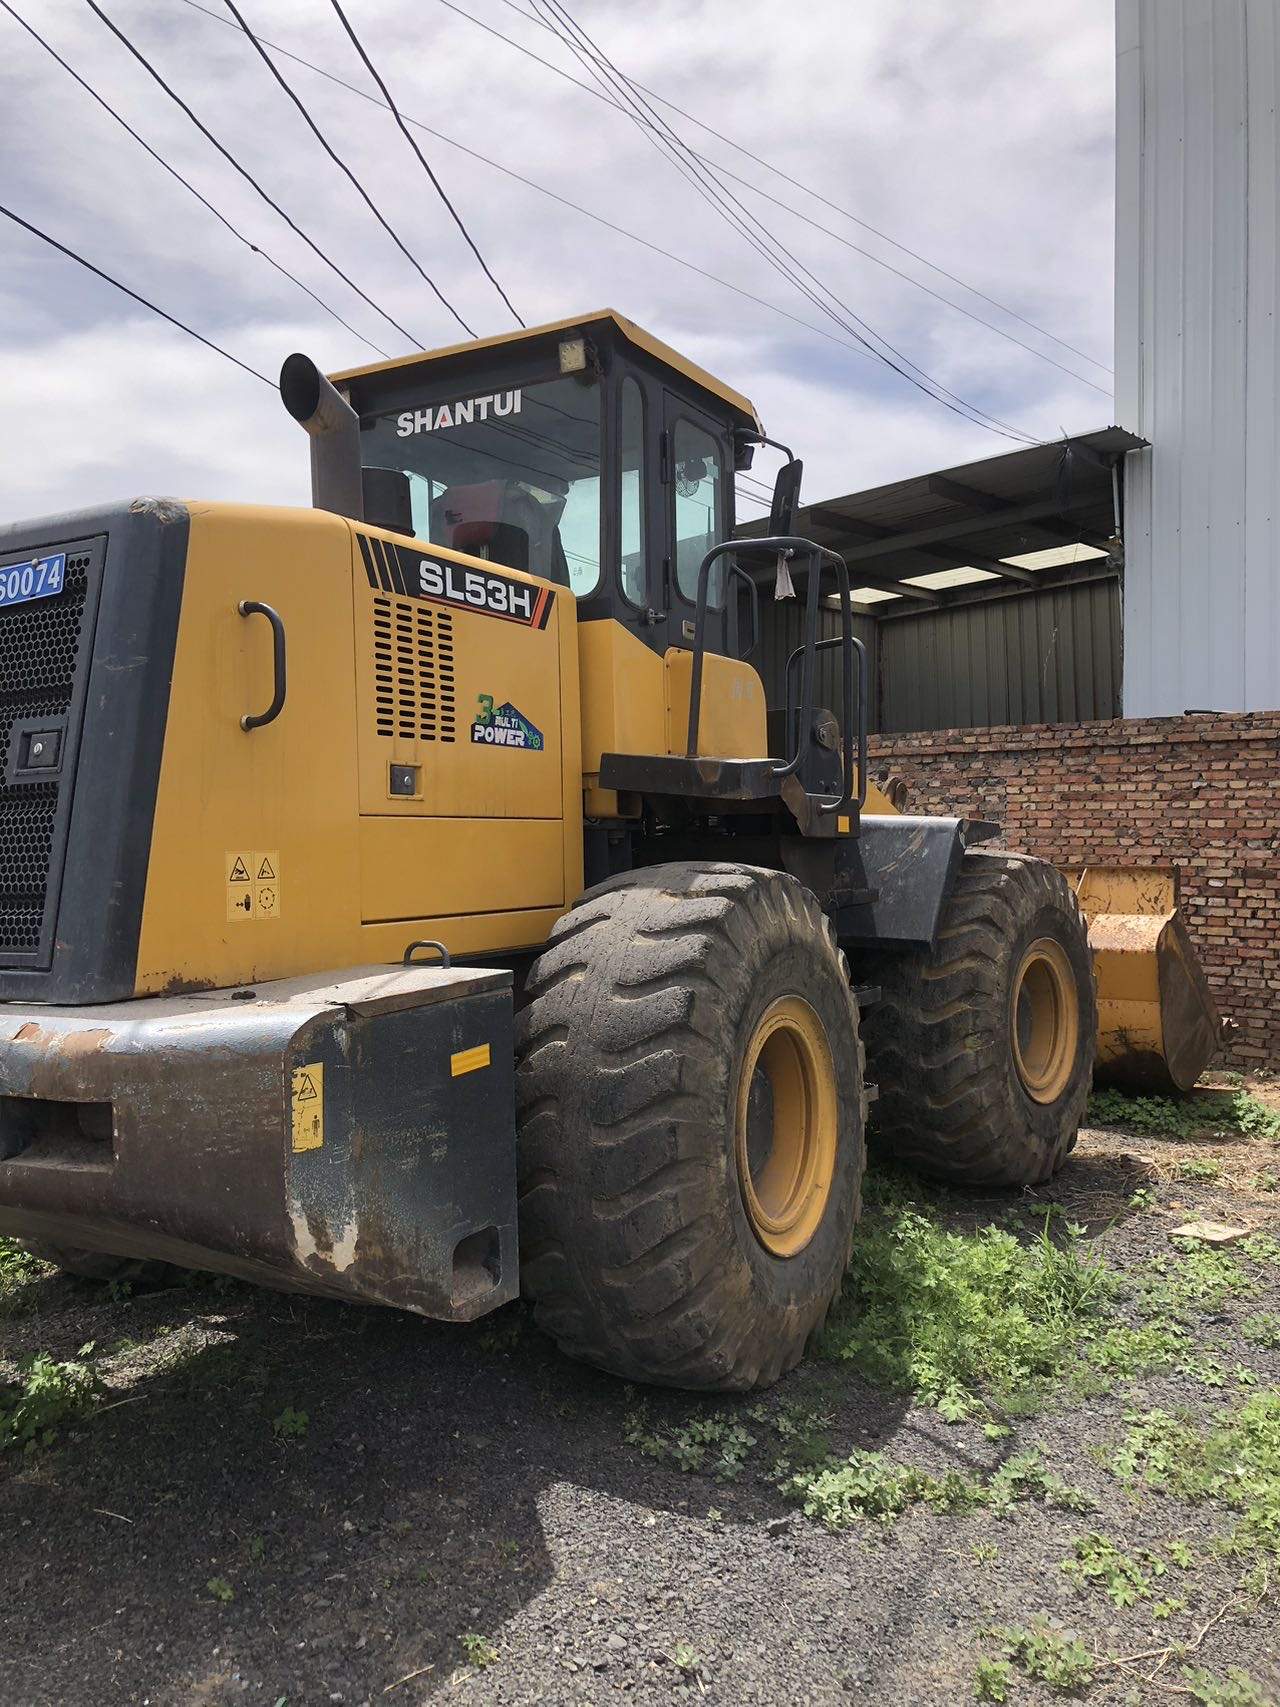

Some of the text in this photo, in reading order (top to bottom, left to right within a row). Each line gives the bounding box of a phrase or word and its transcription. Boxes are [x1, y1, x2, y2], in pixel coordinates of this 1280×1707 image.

[396, 389, 522, 437] SHANTUI
[420, 560, 531, 617] SL53H
[474, 724, 526, 746] POWER
